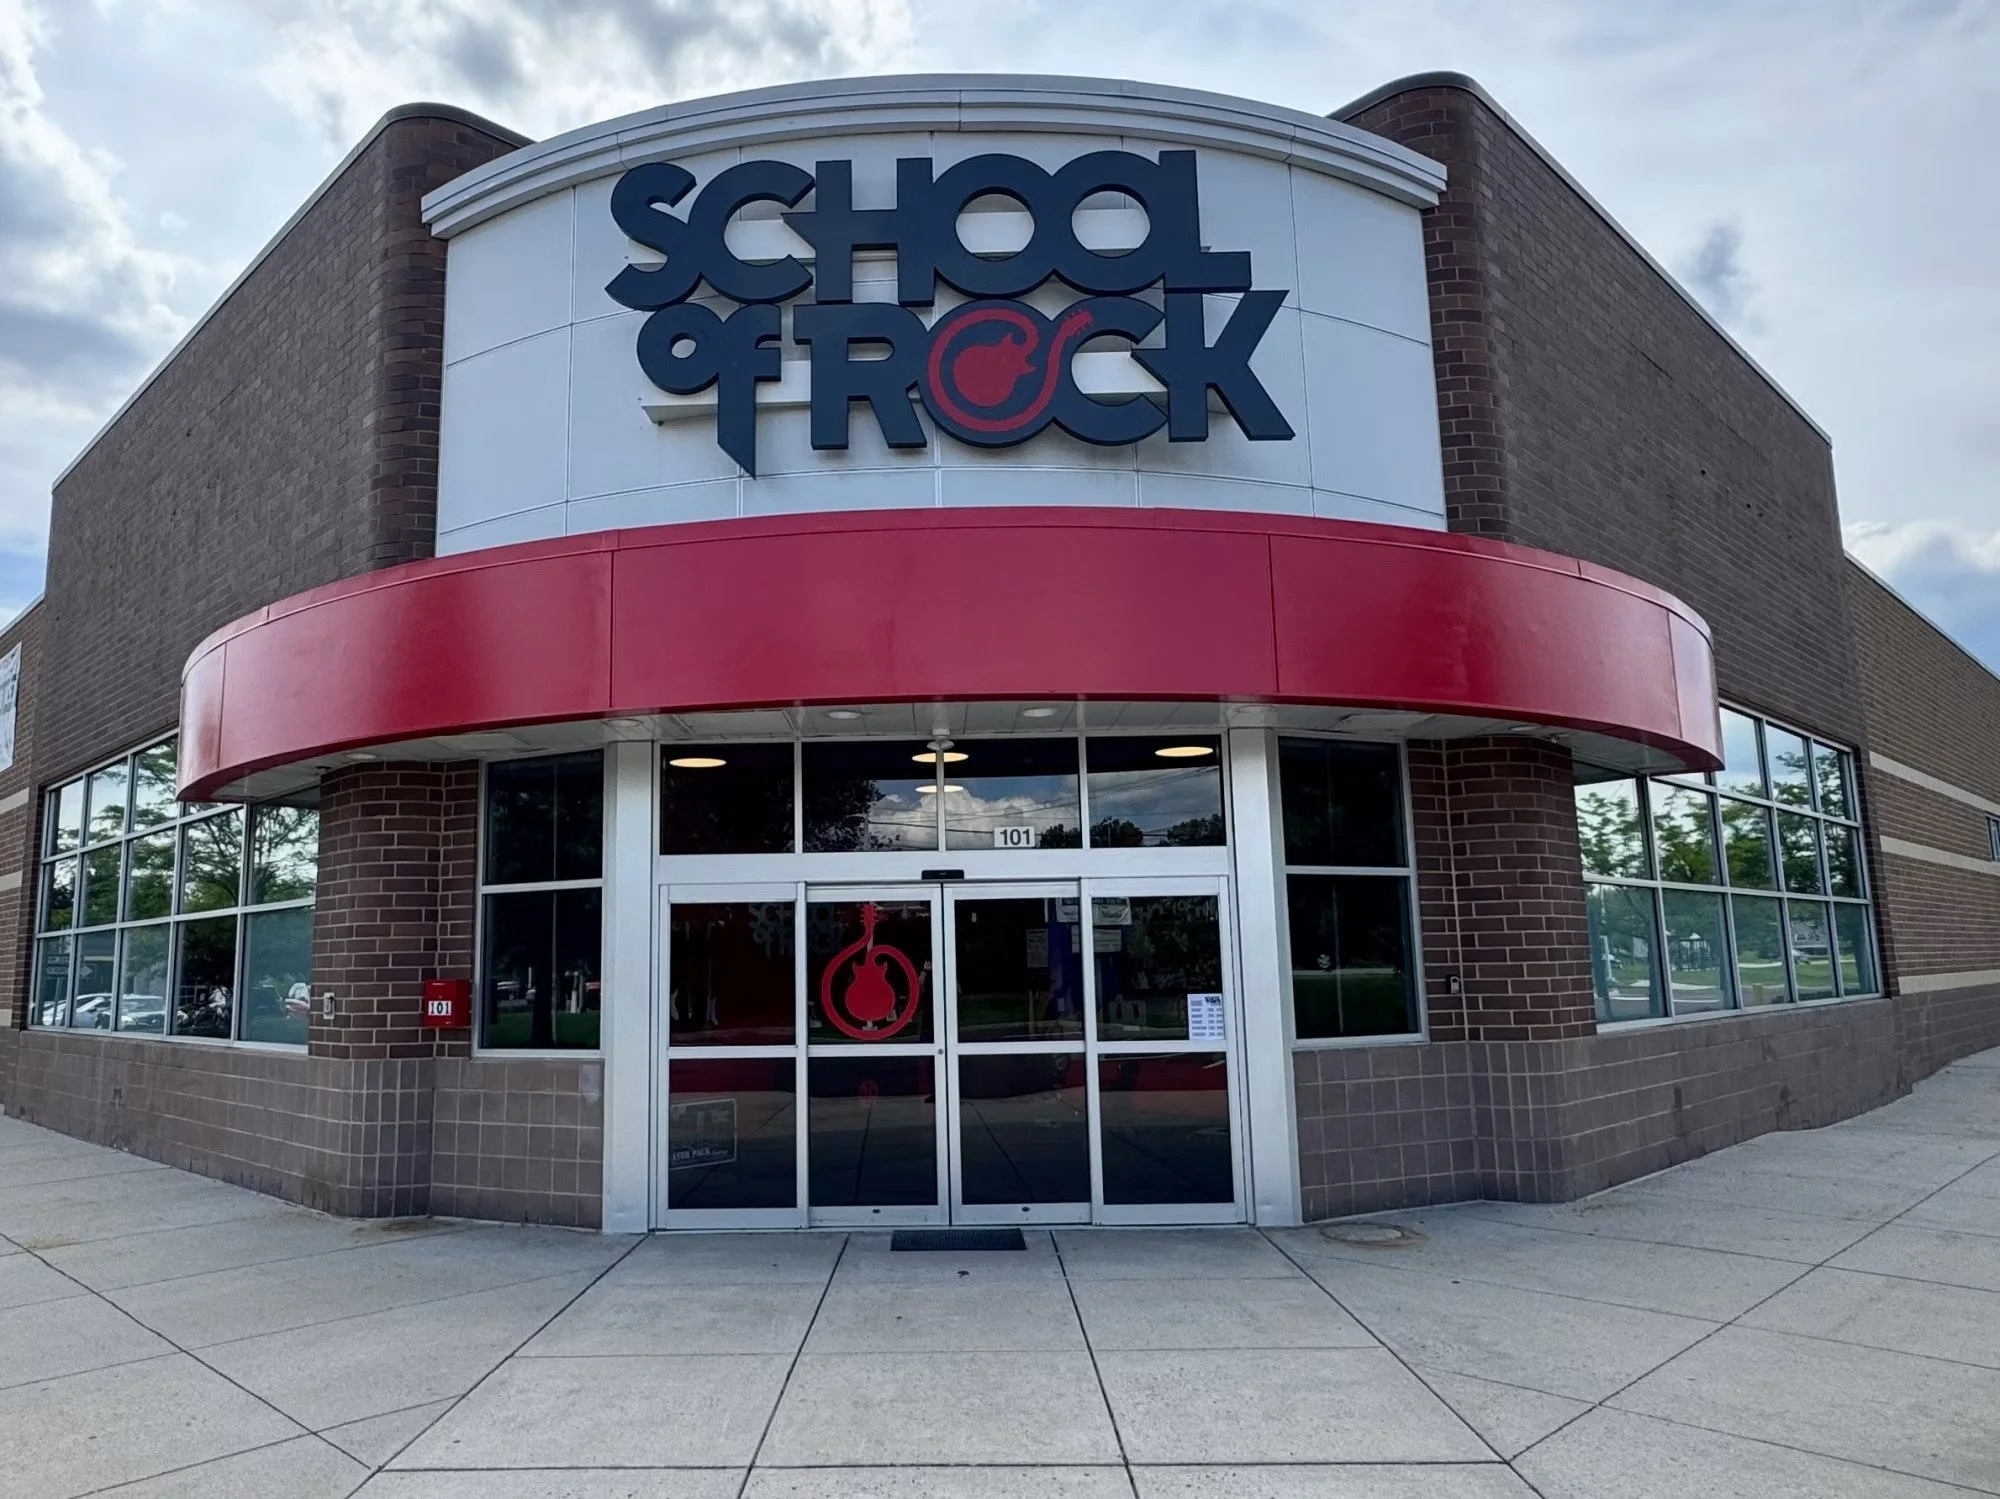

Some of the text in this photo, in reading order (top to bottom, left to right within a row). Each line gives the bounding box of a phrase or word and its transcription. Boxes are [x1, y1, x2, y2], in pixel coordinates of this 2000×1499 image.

[604, 149, 1252, 312] SCHOOL
[793, 290, 1296, 449] ROCK
[999, 828, 1031, 846] 101
[430, 1002, 449, 1015] 101
